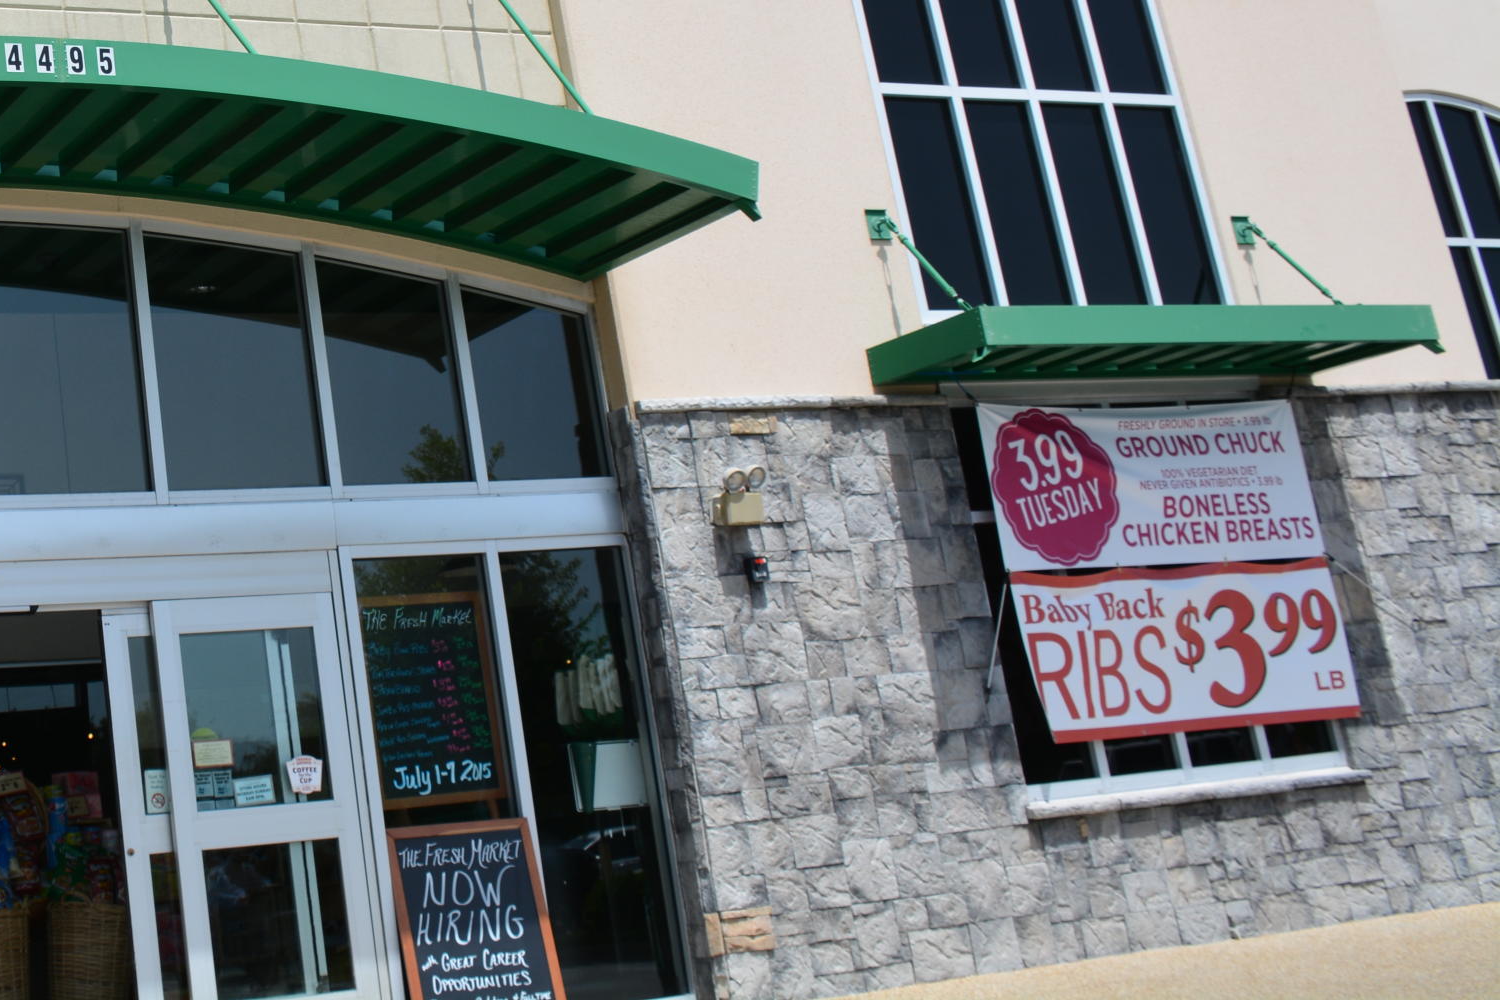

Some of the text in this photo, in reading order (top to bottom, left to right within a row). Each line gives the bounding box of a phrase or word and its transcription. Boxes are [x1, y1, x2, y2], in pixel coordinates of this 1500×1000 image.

[7, 43, 114, 75] 4495
[1118, 419, 1158, 431] FRESHLY
[1159, 418, 1196, 430] GROUND
[1197, 418, 1207, 428] IN
[1209, 417, 1236, 428] STORE
[1243, 416, 1262, 426] 3.99
[1115, 431, 1286, 458] GROUND CHUCK
[1007, 429, 1084, 492] 3.99
[1160, 465, 1258, 479] 100% VEGETARIAN DIET
[1139, 480, 1169, 490] NEVER
[1170, 479, 1198, 489] GIVEN
[1199, 477, 1250, 488] ANTIBIOTICS
[1015, 477, 1103, 531] TUESDAY
[1163, 492, 1271, 519] BONELESS
[1122, 516, 1315, 547] CHICKEN BREASTS
[363, 607, 388, 632] THE
[1020, 587, 1166, 631] Baby Back
[1026, 625, 1172, 720] RIBS
[1314, 669, 1346, 692] LB
[292, 766, 317, 774] COFFEE
[299, 777, 313, 785] CUP
[393, 765, 433, 796] July
[460, 759, 492, 782] 2015
[398, 838, 523, 870] THE FRESH MARKET
[422, 864, 516, 909] NOW
[416, 904, 525, 947] HIRING
[441, 952, 477, 973] GREAT
[482, 948, 530, 971] CAREER
[432, 970, 533, 996] OPPORTUNITIES
